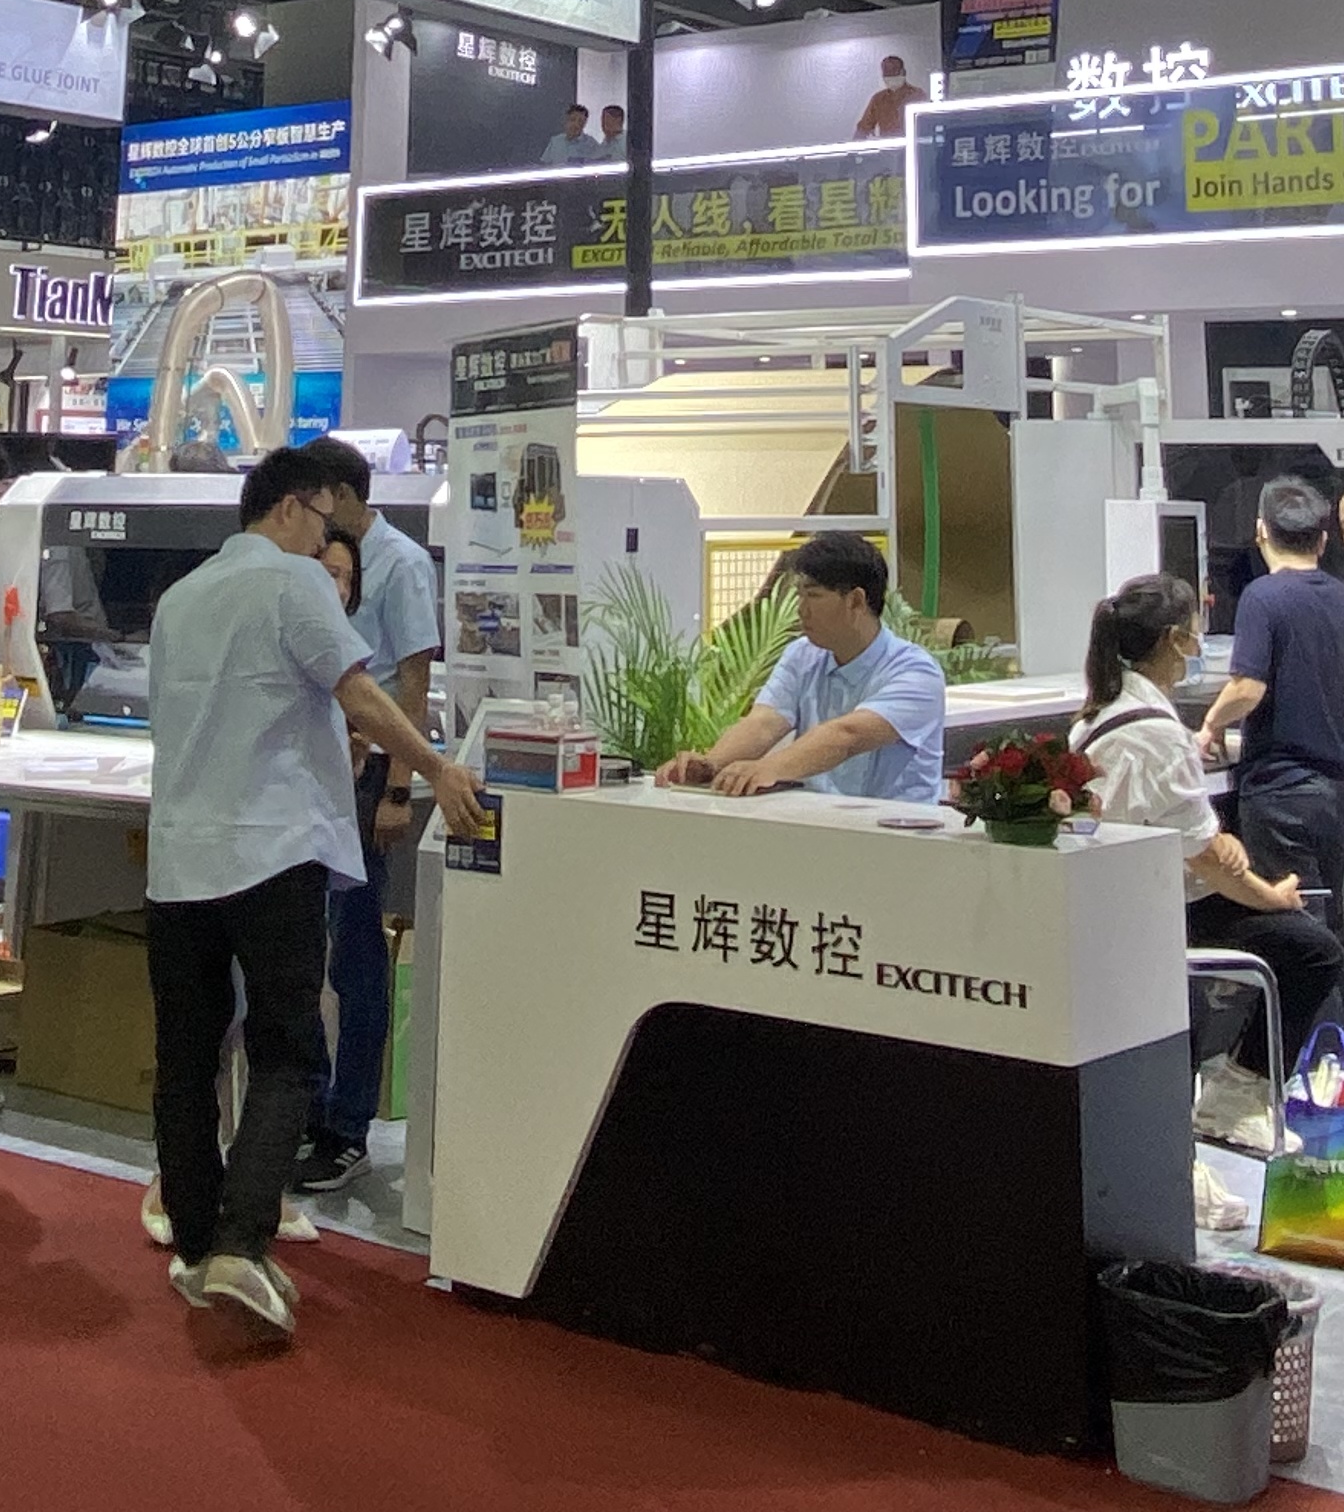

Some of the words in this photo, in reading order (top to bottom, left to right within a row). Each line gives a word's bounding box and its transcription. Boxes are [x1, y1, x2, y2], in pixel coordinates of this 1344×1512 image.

[10, 64, 52, 87] GLUE
[55, 70, 101, 96] JOINT
[951, 131, 1079, 168] 星辉数控
[955, 177, 1095, 220] Looking
[1103, 172, 1162, 209] for
[1192, 173, 1244, 200] Join
[1252, 166, 1335, 196] Hands
[399, 199, 557, 254] 星辉数控
[735, 233, 827, 257] Affordable
[832, 228, 878, 247] Total
[459, 247, 554, 270] EXCITECH
[633, 889, 864, 980] 星辉数控
[875, 961, 1029, 1010] EXCITECH
